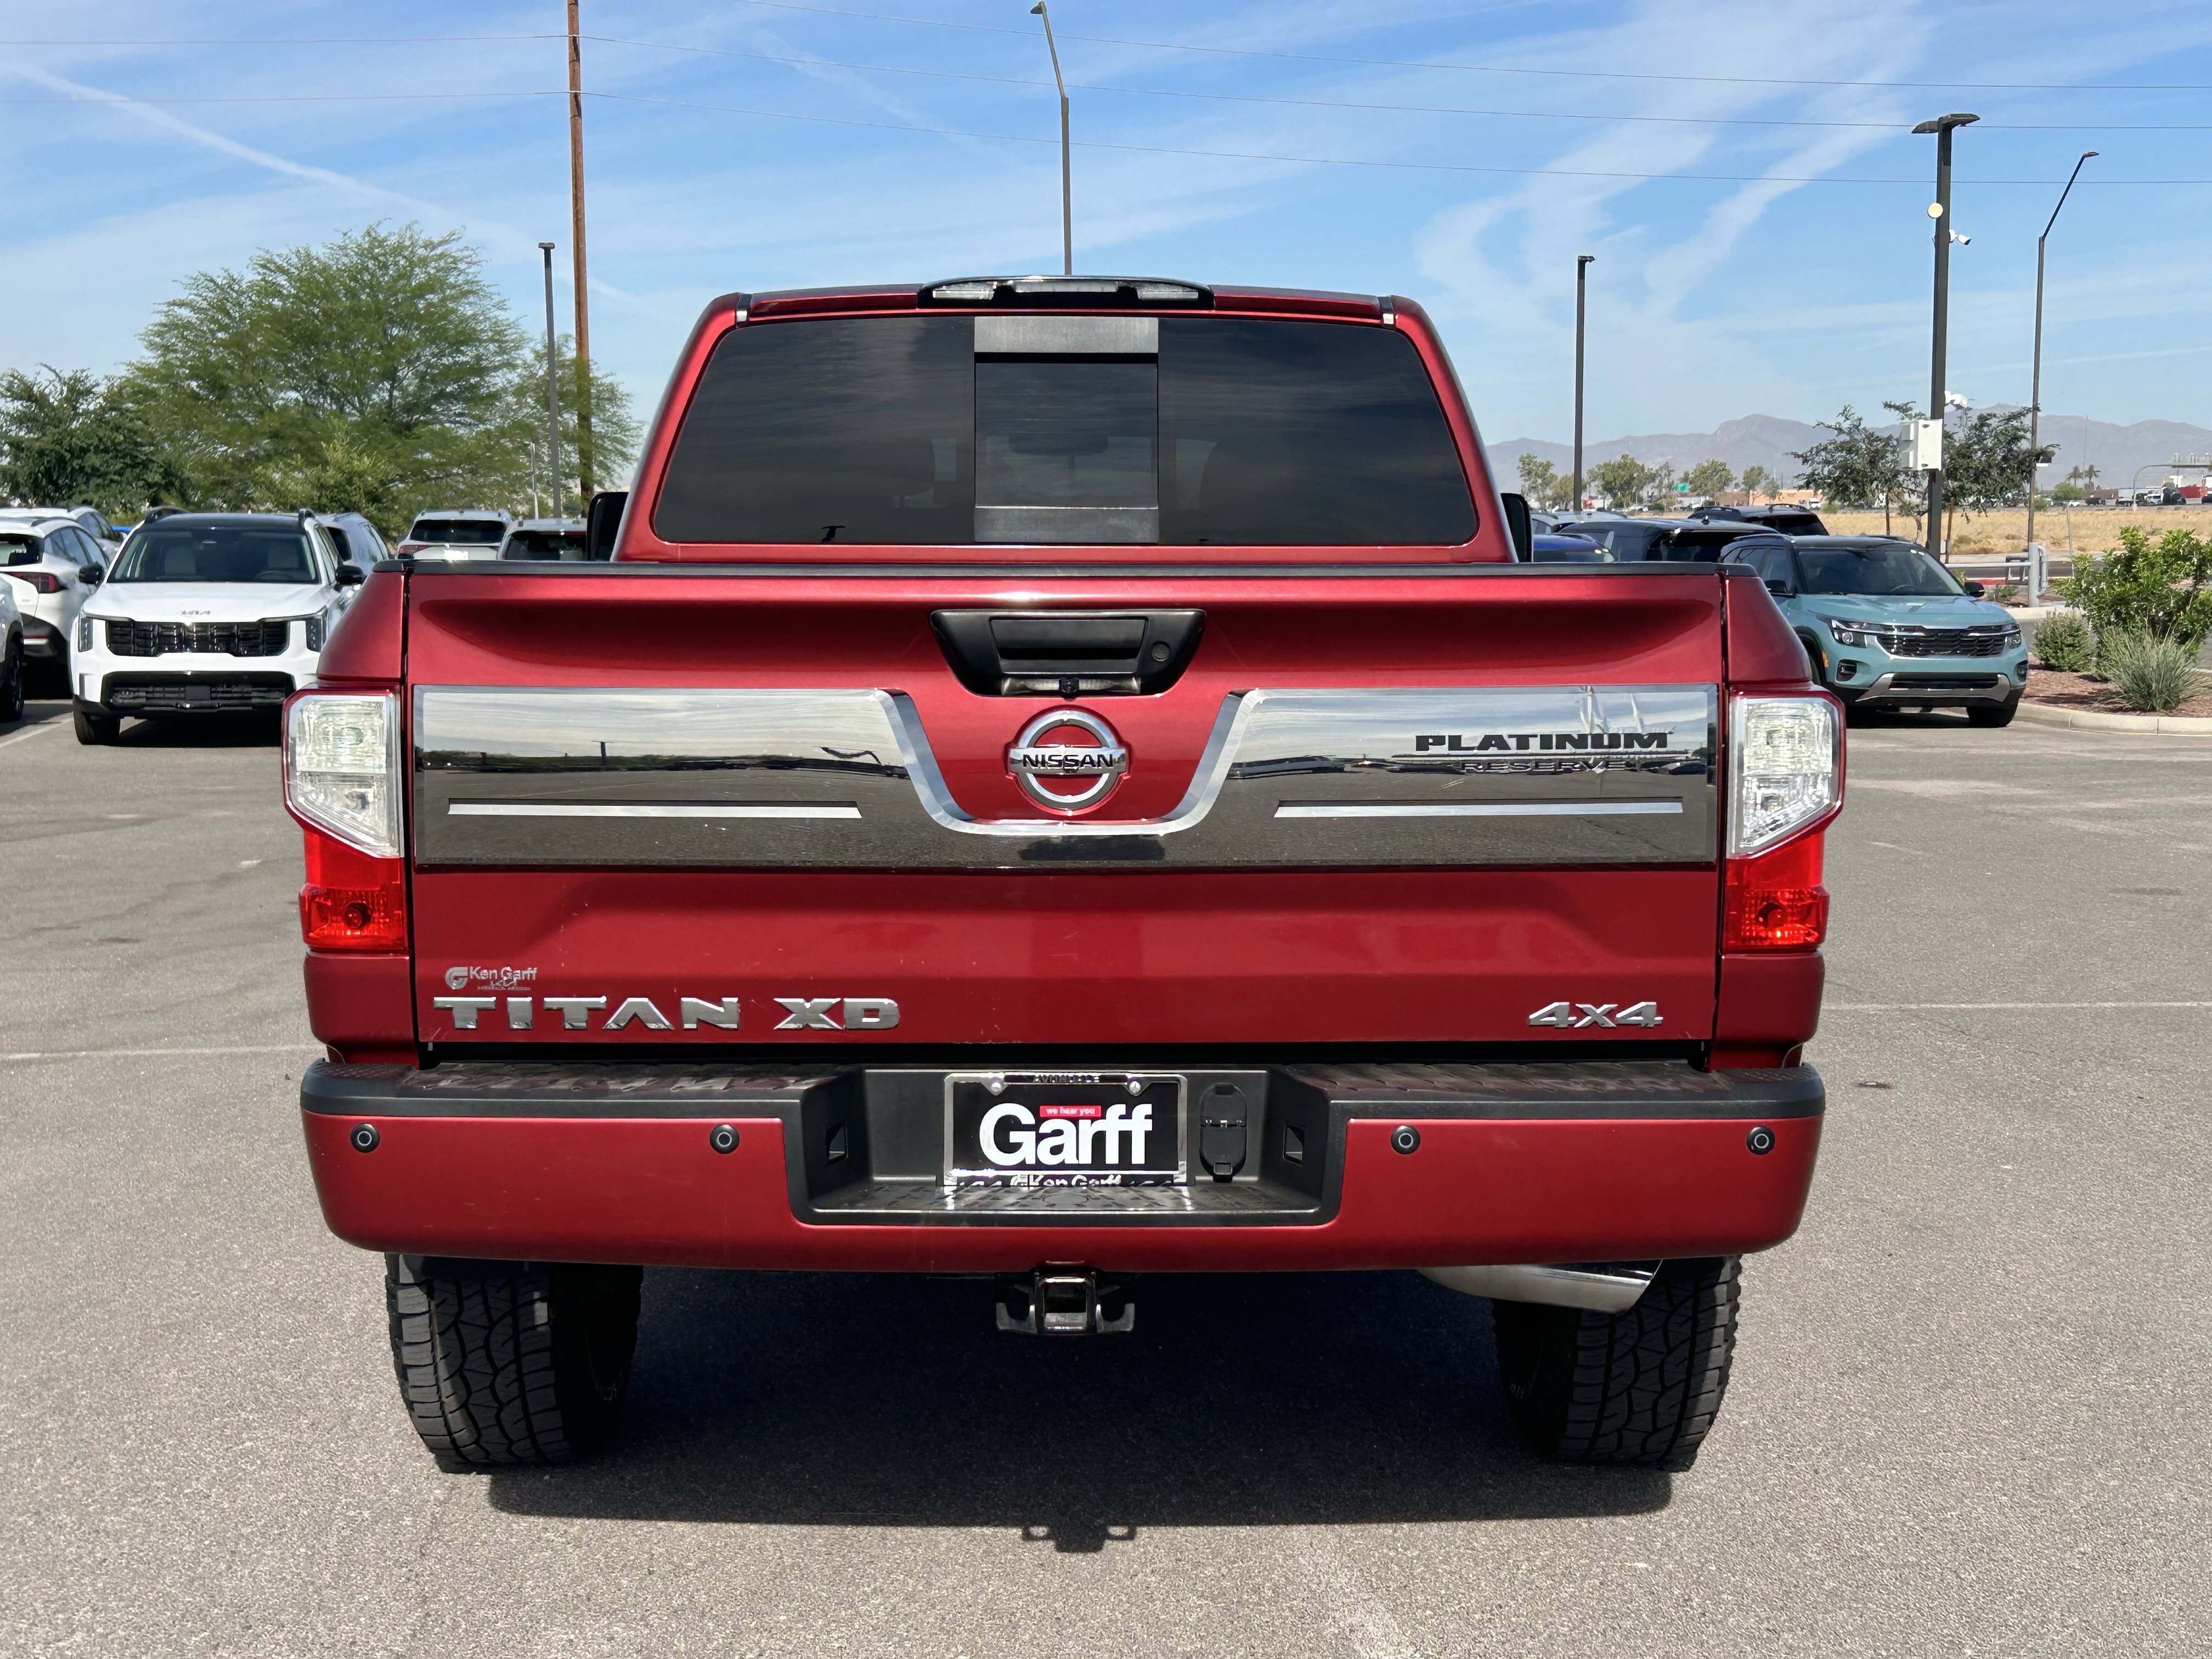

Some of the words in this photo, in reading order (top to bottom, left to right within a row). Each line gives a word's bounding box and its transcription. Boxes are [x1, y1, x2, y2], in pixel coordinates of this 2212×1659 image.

[1415, 733, 1668, 751] PLATINUM
[1023, 754, 1114, 768] NISSAN
[469, 966, 498, 980] Ken
[500, 966, 537, 981] Garff
[433, 996, 740, 1030] TITAN
[773, 997, 900, 1030] XD
[1059, 1106, 1078, 1115] hear
[1079, 1108, 1096, 1116] you
[979, 1103, 1153, 1166] Garff
